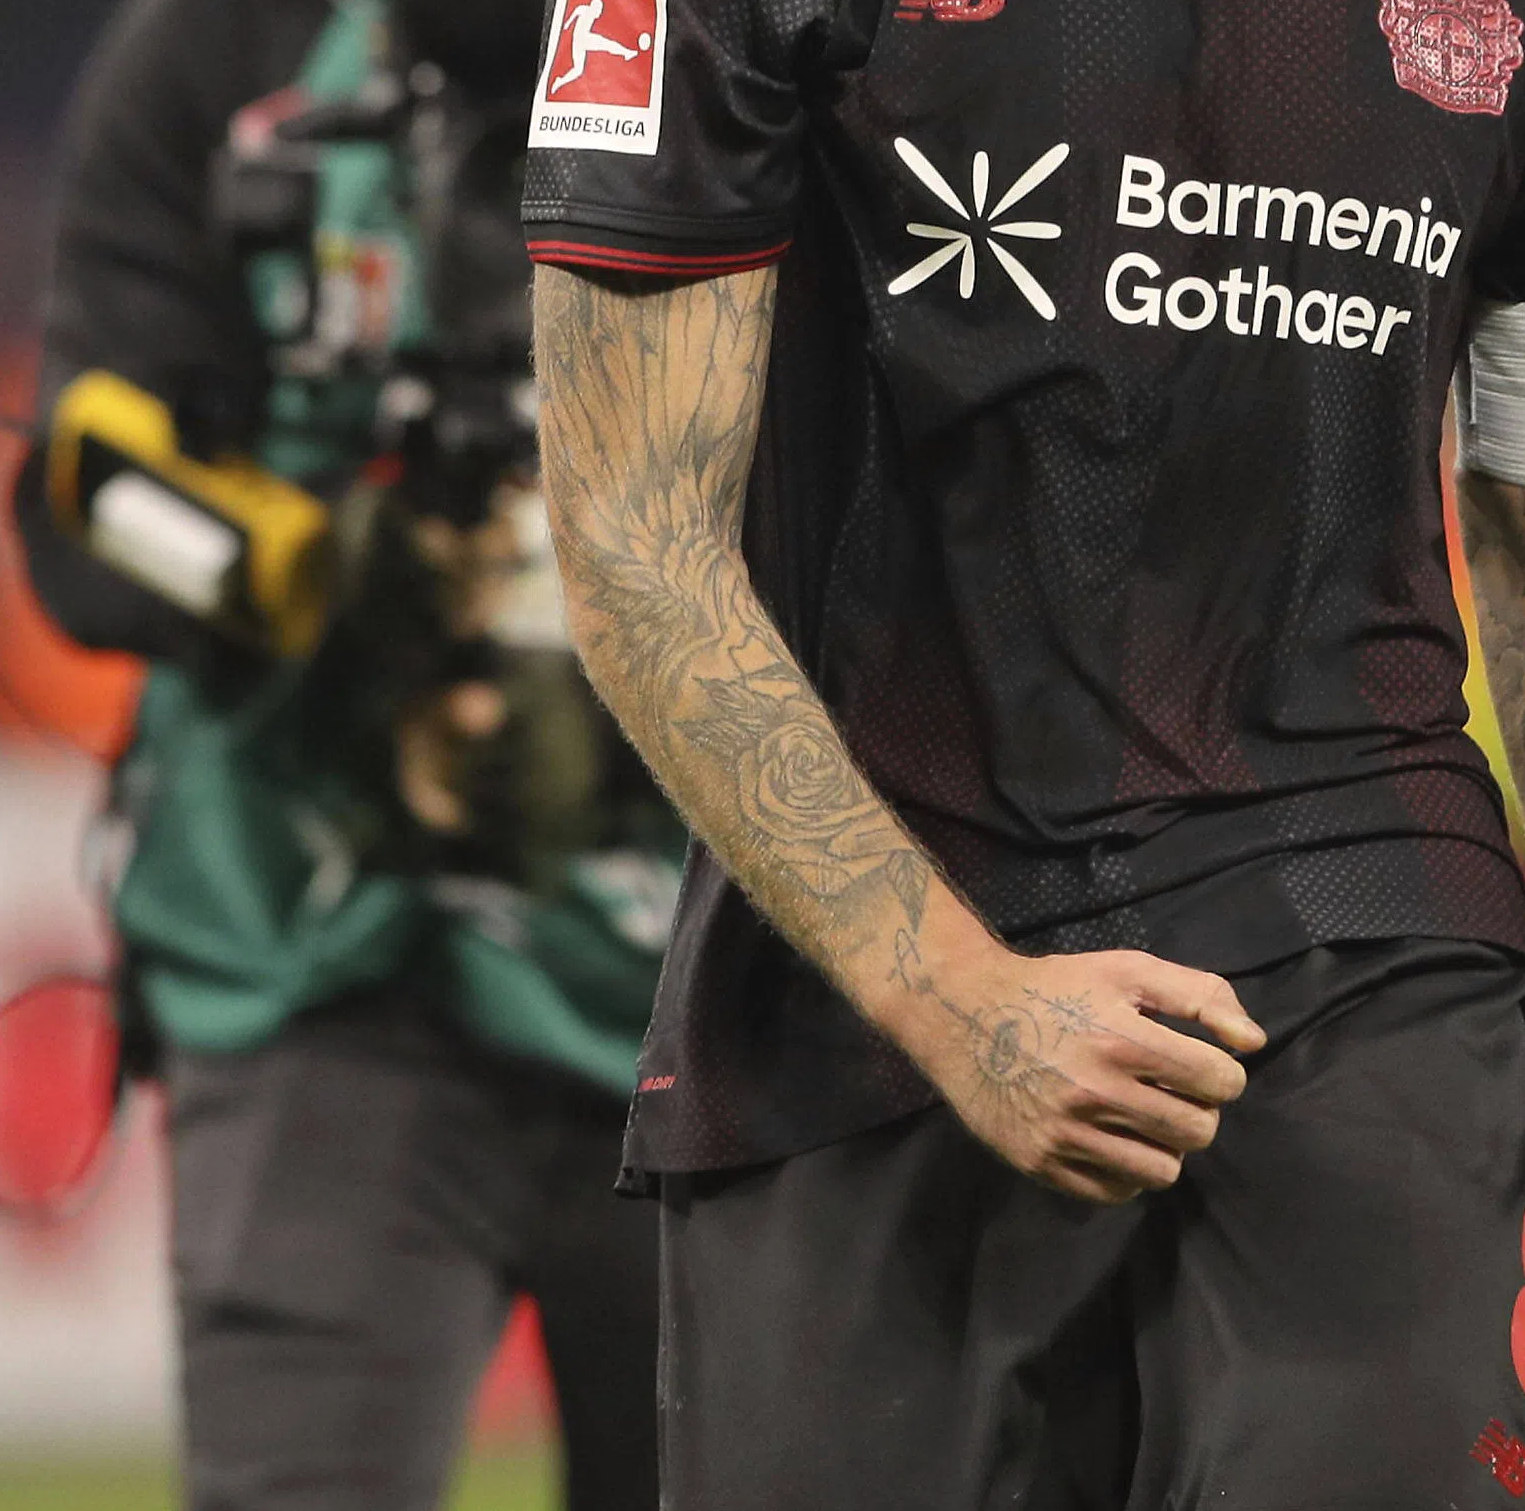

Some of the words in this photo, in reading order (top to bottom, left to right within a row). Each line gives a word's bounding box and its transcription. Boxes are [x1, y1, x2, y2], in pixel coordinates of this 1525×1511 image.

[539, 115, 645, 137] BUNDESLIGA
[1116, 154, 1461, 278] Barmenia
[1104, 251, 1412, 356] Gothaer
